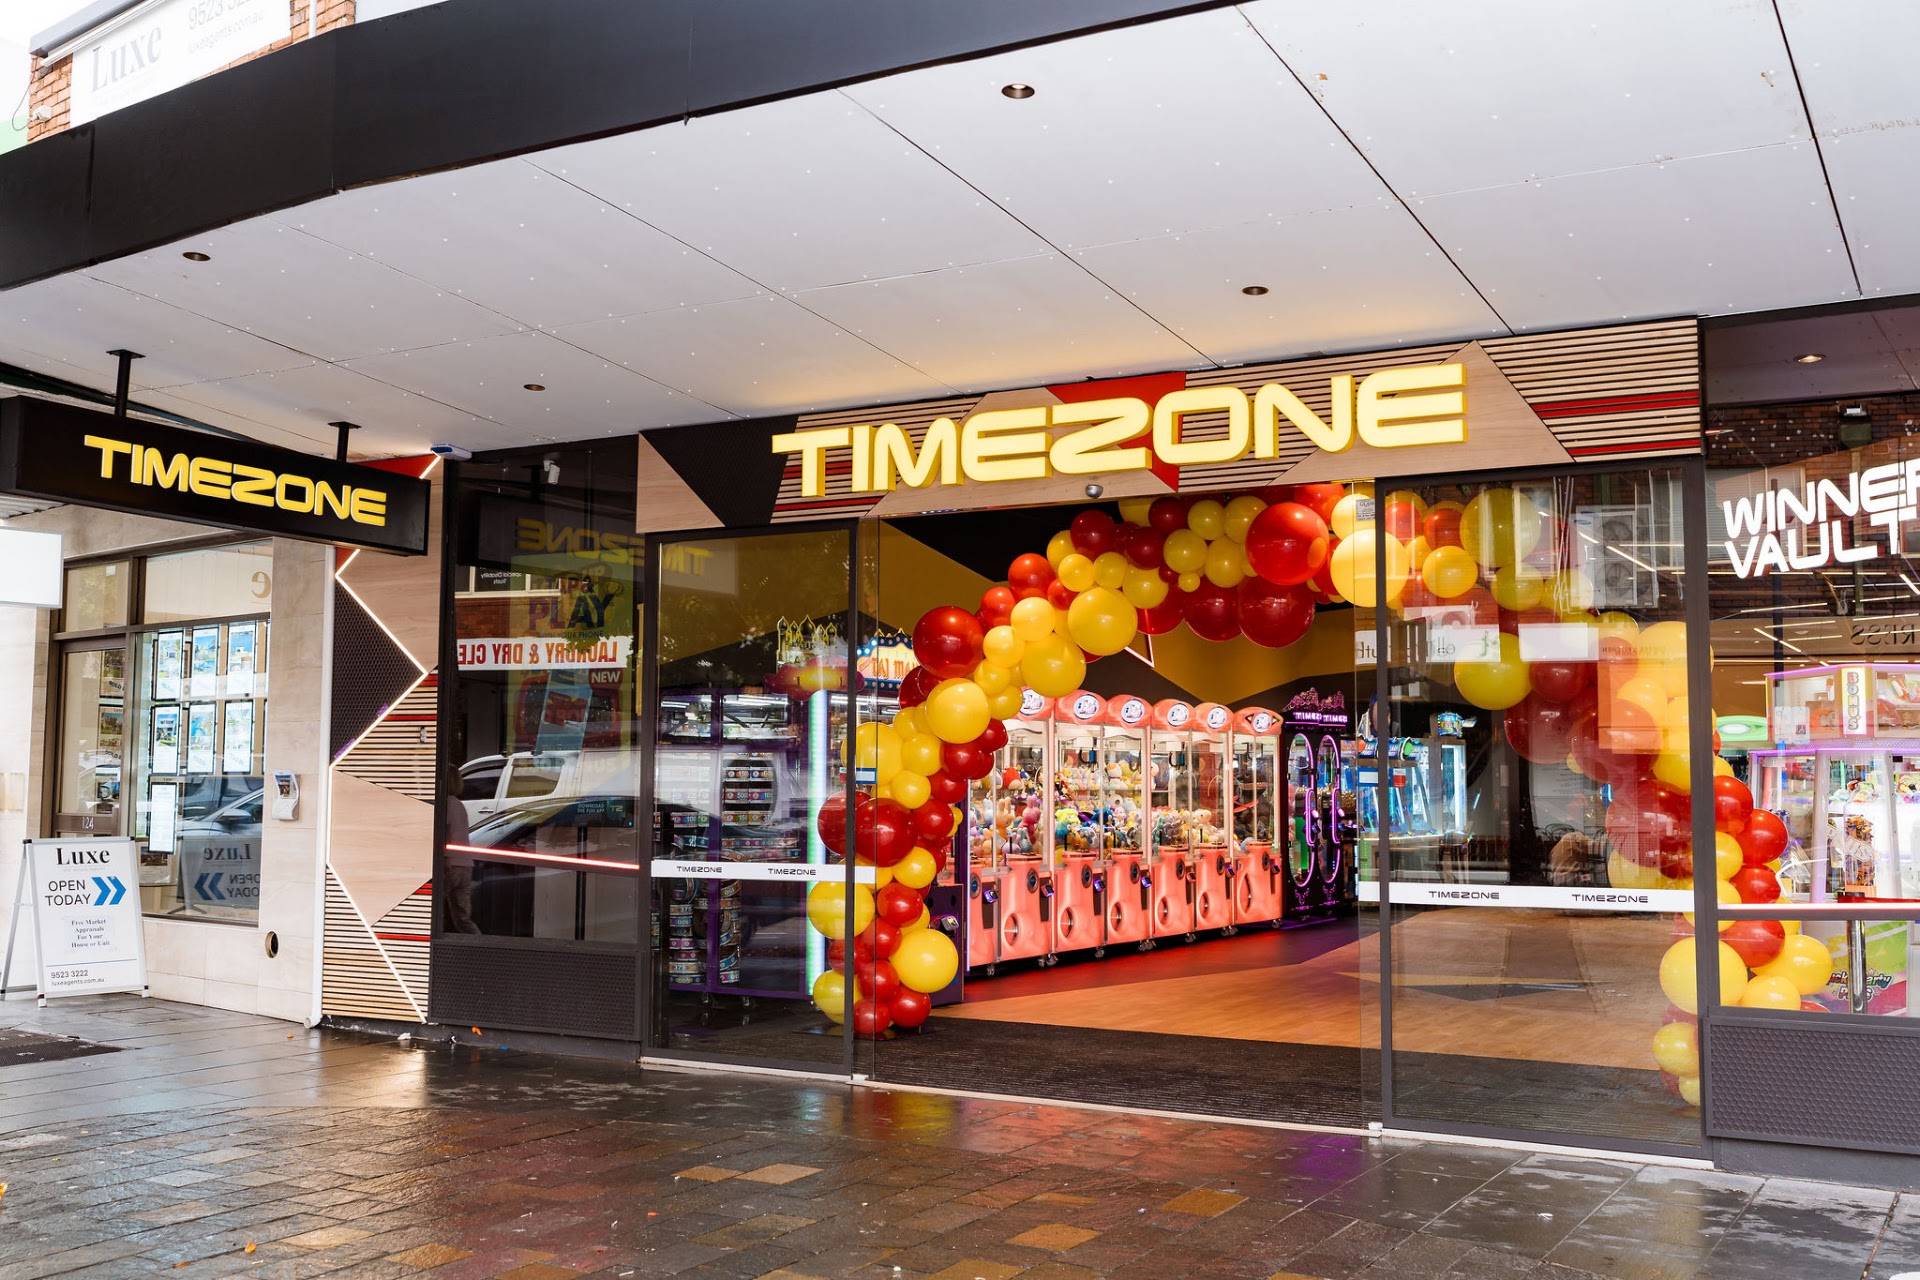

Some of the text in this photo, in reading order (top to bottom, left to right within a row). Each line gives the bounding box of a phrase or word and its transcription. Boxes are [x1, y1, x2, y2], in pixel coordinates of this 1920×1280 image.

[188, 0, 223, 31] 9523
[91, 26, 162, 92] Luxe
[771, 362, 1468, 497] TIMEZONE
[84, 434, 387, 527] TIMEZONE
[1724, 505, 1918, 579] VAULT
[528, 594, 616, 630] PLAY
[578, 629, 604, 639] PHONE
[871, 657, 889, 679] TAJ
[591, 671, 621, 683] NEW
[82, 817, 94, 829] 124
[56, 847, 110, 865] Luxe
[677, 865, 722, 873] TIMEZONE
[768, 867, 816, 875] TIMEZONE
[48, 879, 86, 892] OPEN
[45, 893, 91, 906] TODAY
[1428, 890, 1500, 900] TIMEZONE
[1571, 893, 1648, 903] TIMEZONE
[75, 926, 104, 934] Appraisals
[51, 969, 88, 979] 9523 3222
[51, 978, 105, 986] luxeagents.com.au
